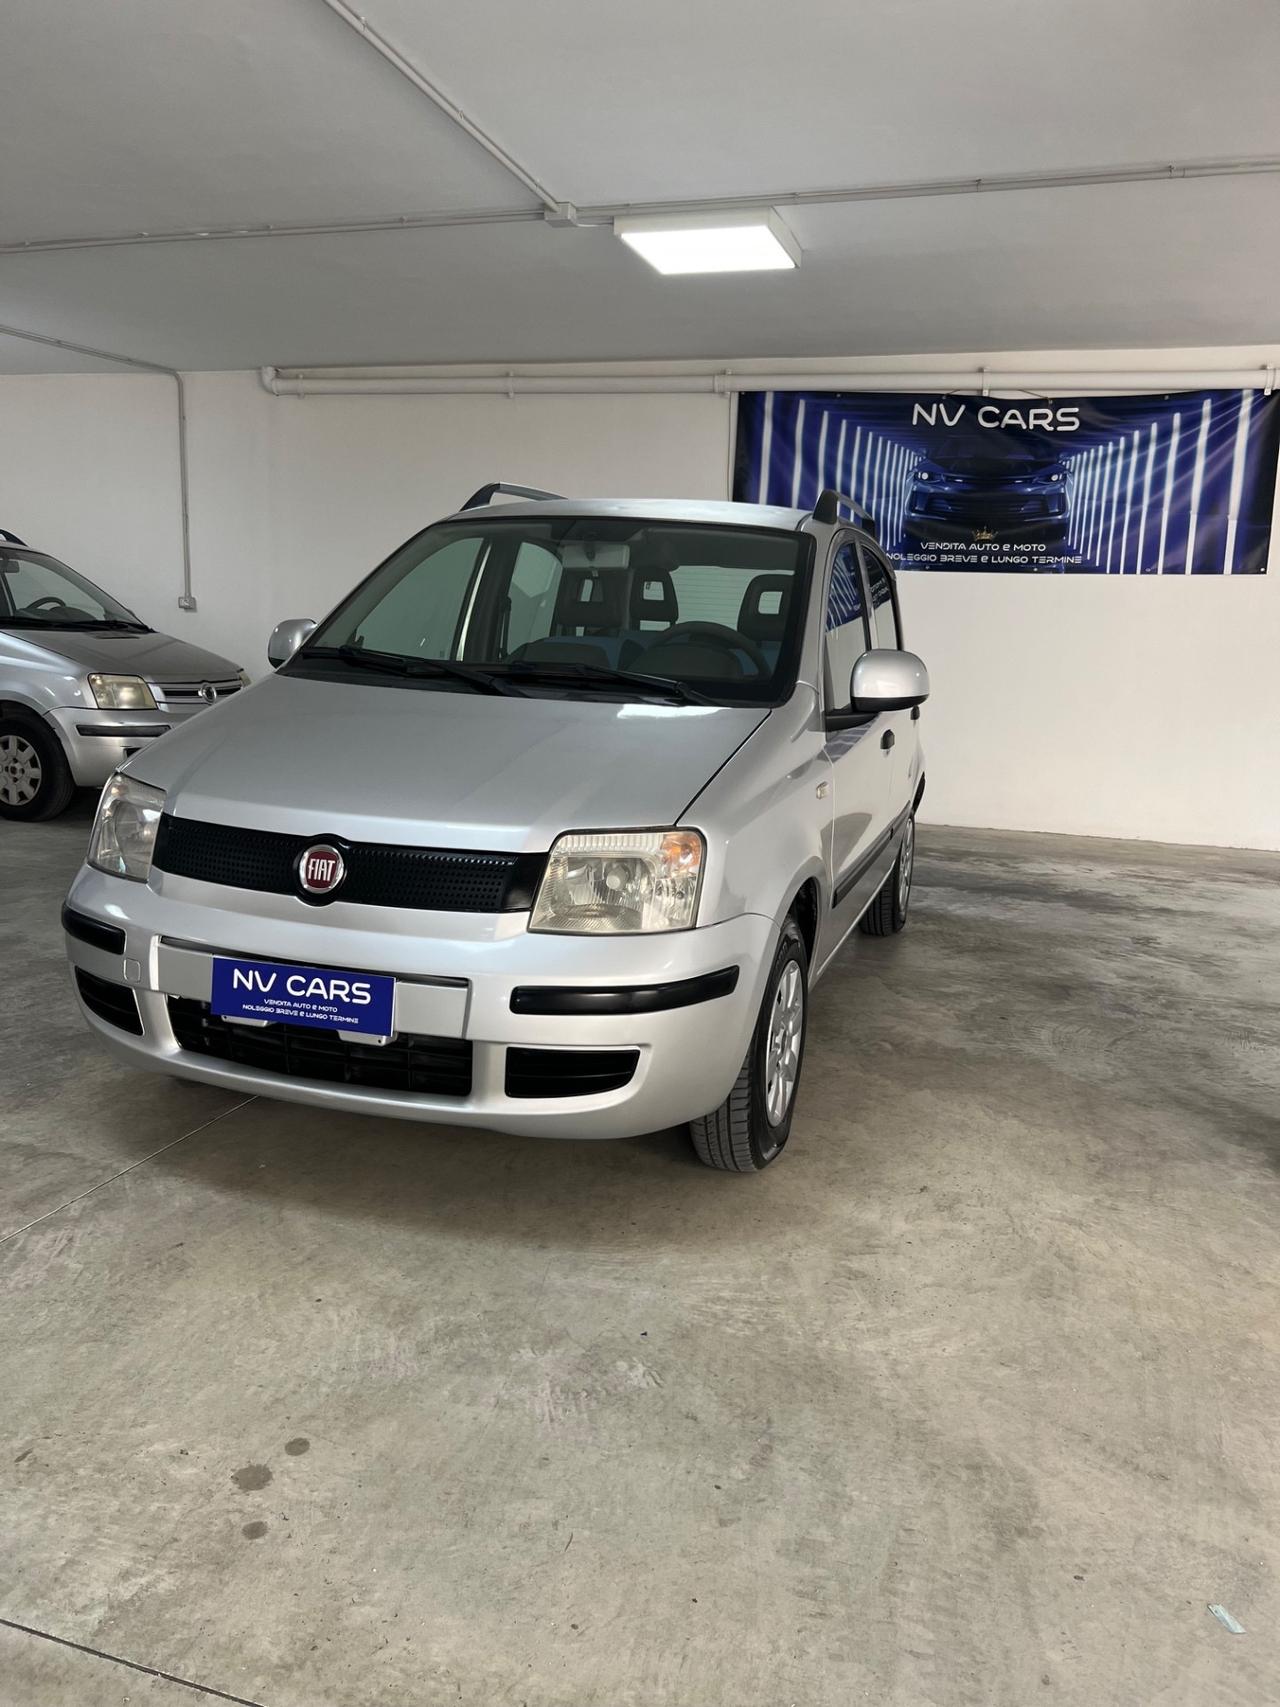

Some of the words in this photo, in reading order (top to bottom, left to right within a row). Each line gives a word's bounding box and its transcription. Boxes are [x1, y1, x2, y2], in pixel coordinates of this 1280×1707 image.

[911, 402, 966, 427] NV
[977, 405, 1081, 431] CARS
[920, 541, 966, 551] VENDITA
[968, 543, 1000, 552] AUTO
[1013, 543, 1047, 552] MOTO
[886, 552, 938, 562] NOLEGGIO
[940, 554, 978, 563] BREVE
[991, 556, 1029, 564] LUNGO
[1032, 556, 1083, 564] TERMINE
[307, 858, 336, 882] FIAT
[232, 967, 277, 993] NV
[286, 974, 372, 1005] CARS
[263, 998, 292, 1007] VENDITA
[318, 1005, 338, 1013] MOTO
